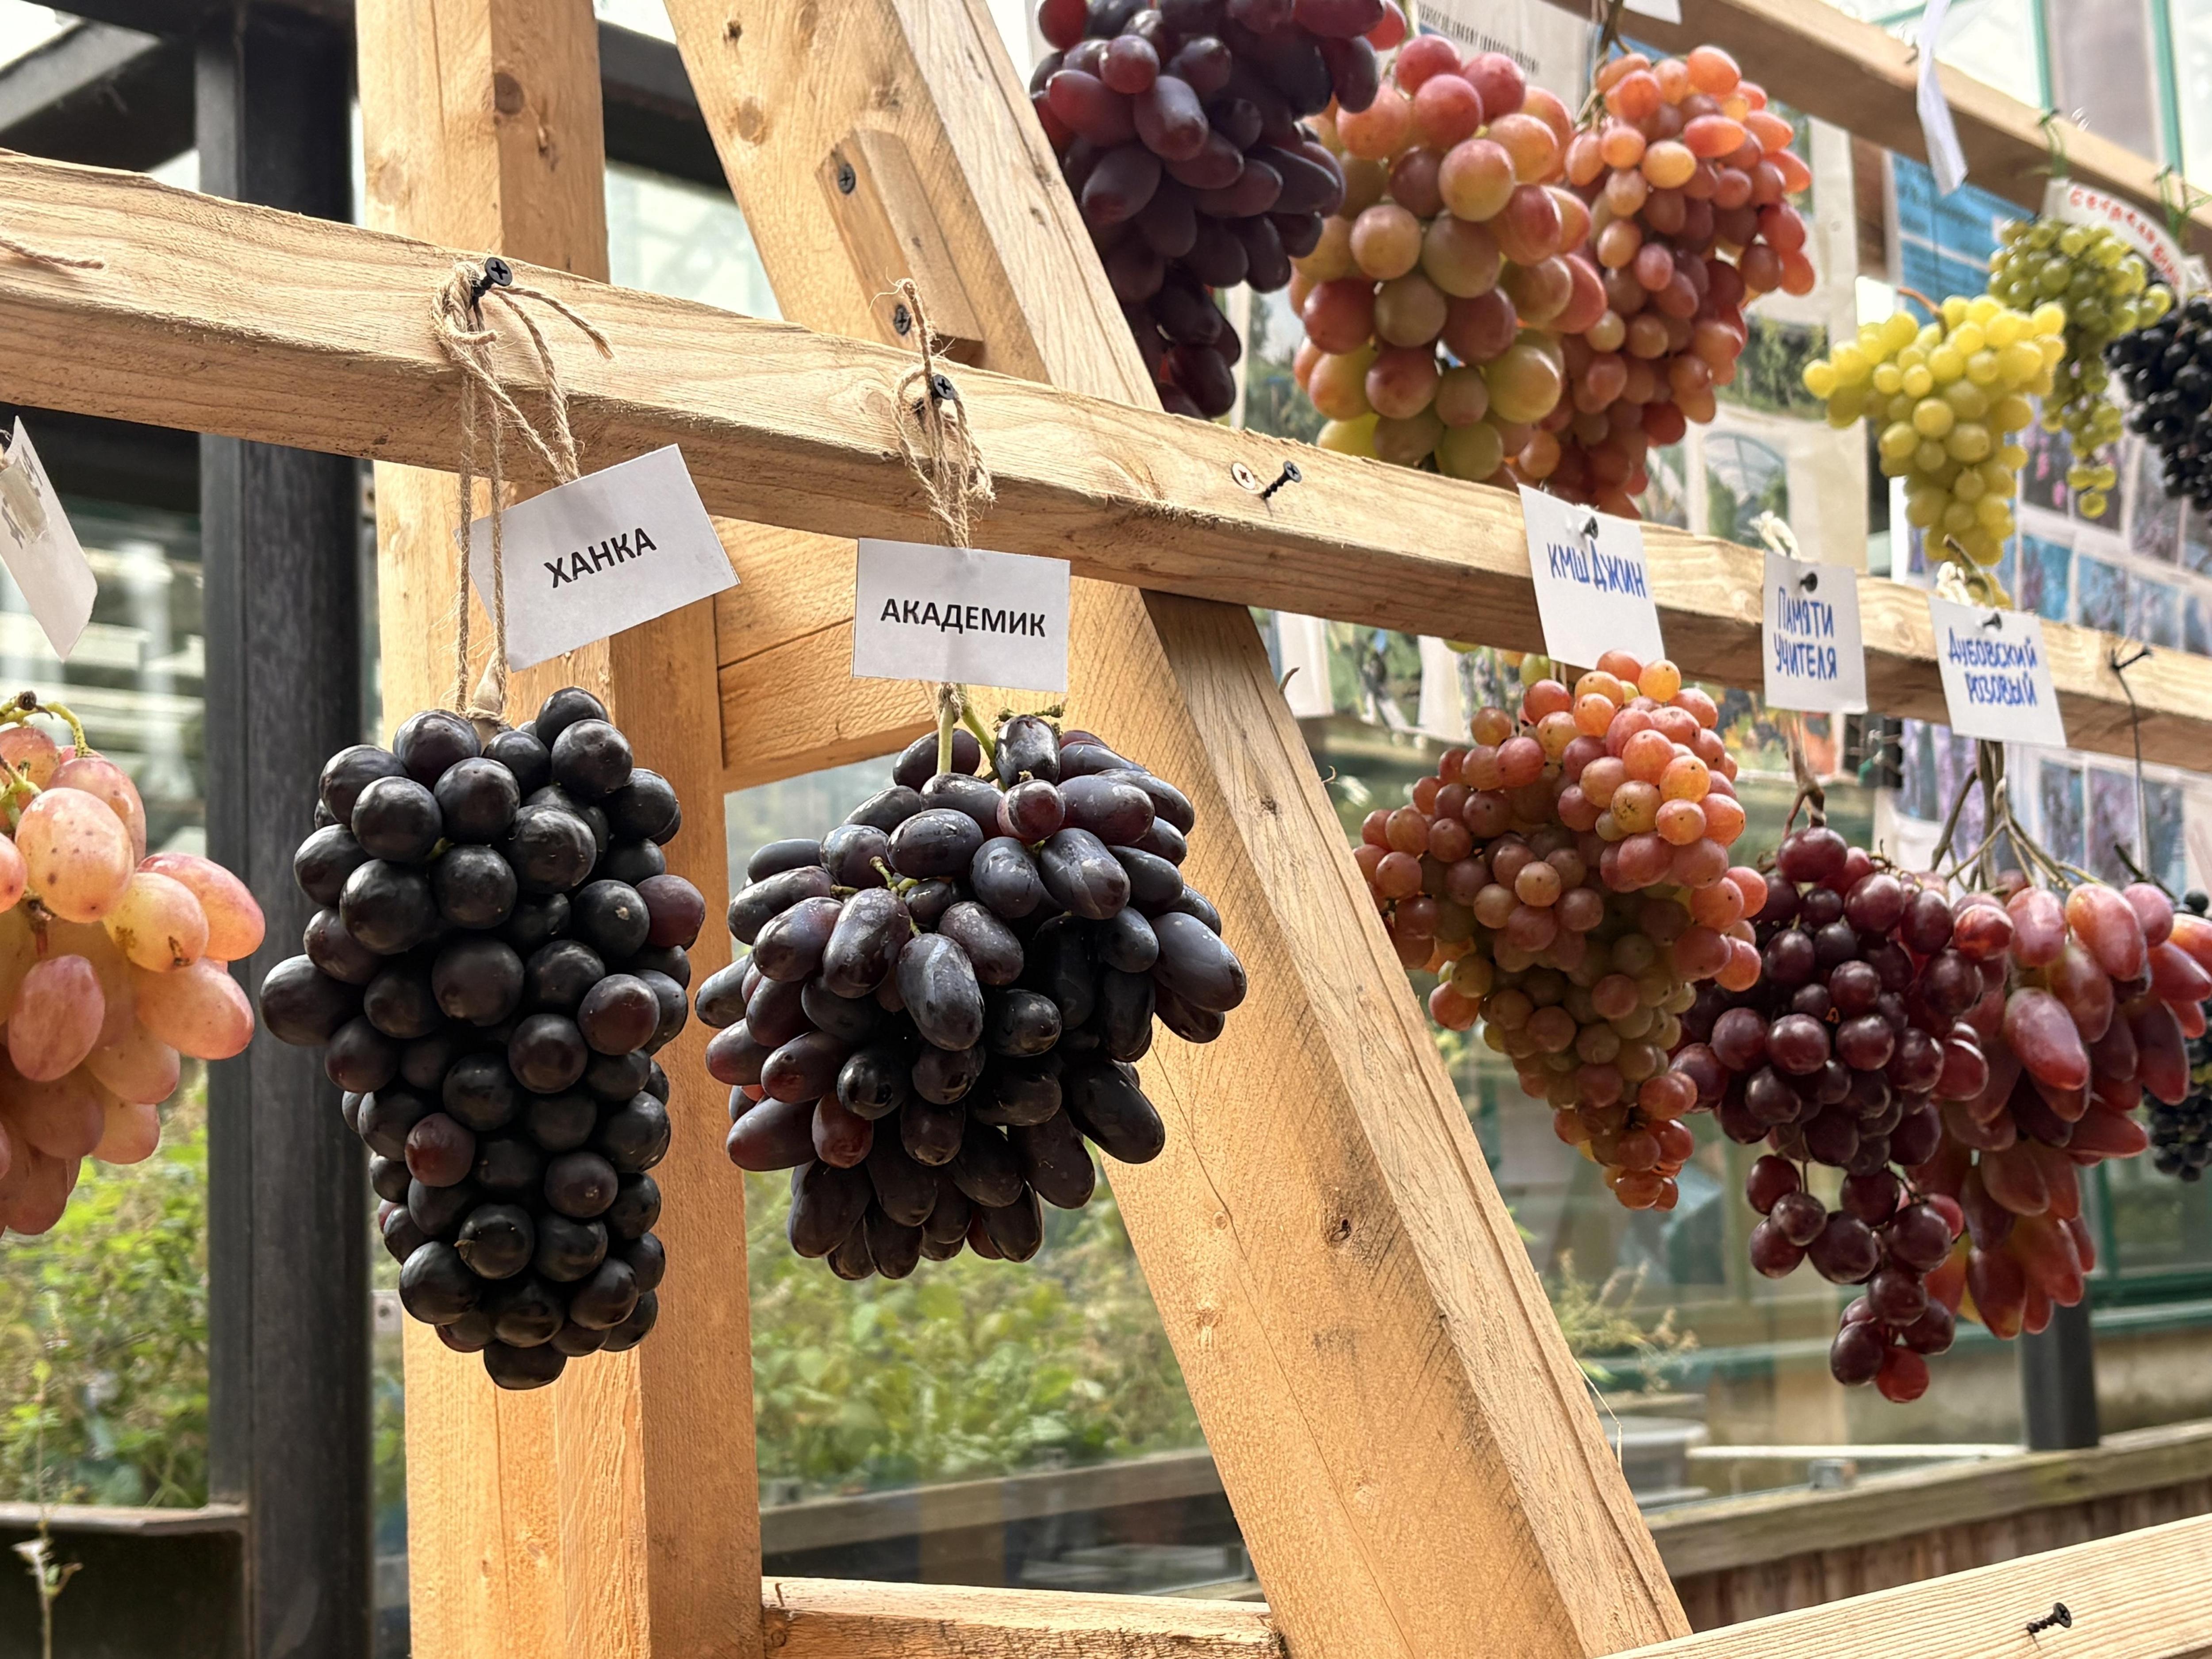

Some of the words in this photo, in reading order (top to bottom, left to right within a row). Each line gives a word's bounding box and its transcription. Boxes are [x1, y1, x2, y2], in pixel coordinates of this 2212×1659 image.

[544, 528, 657, 588] ХАНКА
[880, 598, 1046, 637] АКАДЕМИК
[1778, 585, 1834, 640] ПАМЯТИ
[1774, 632, 1837, 680] УЧИТЕЛЯ
